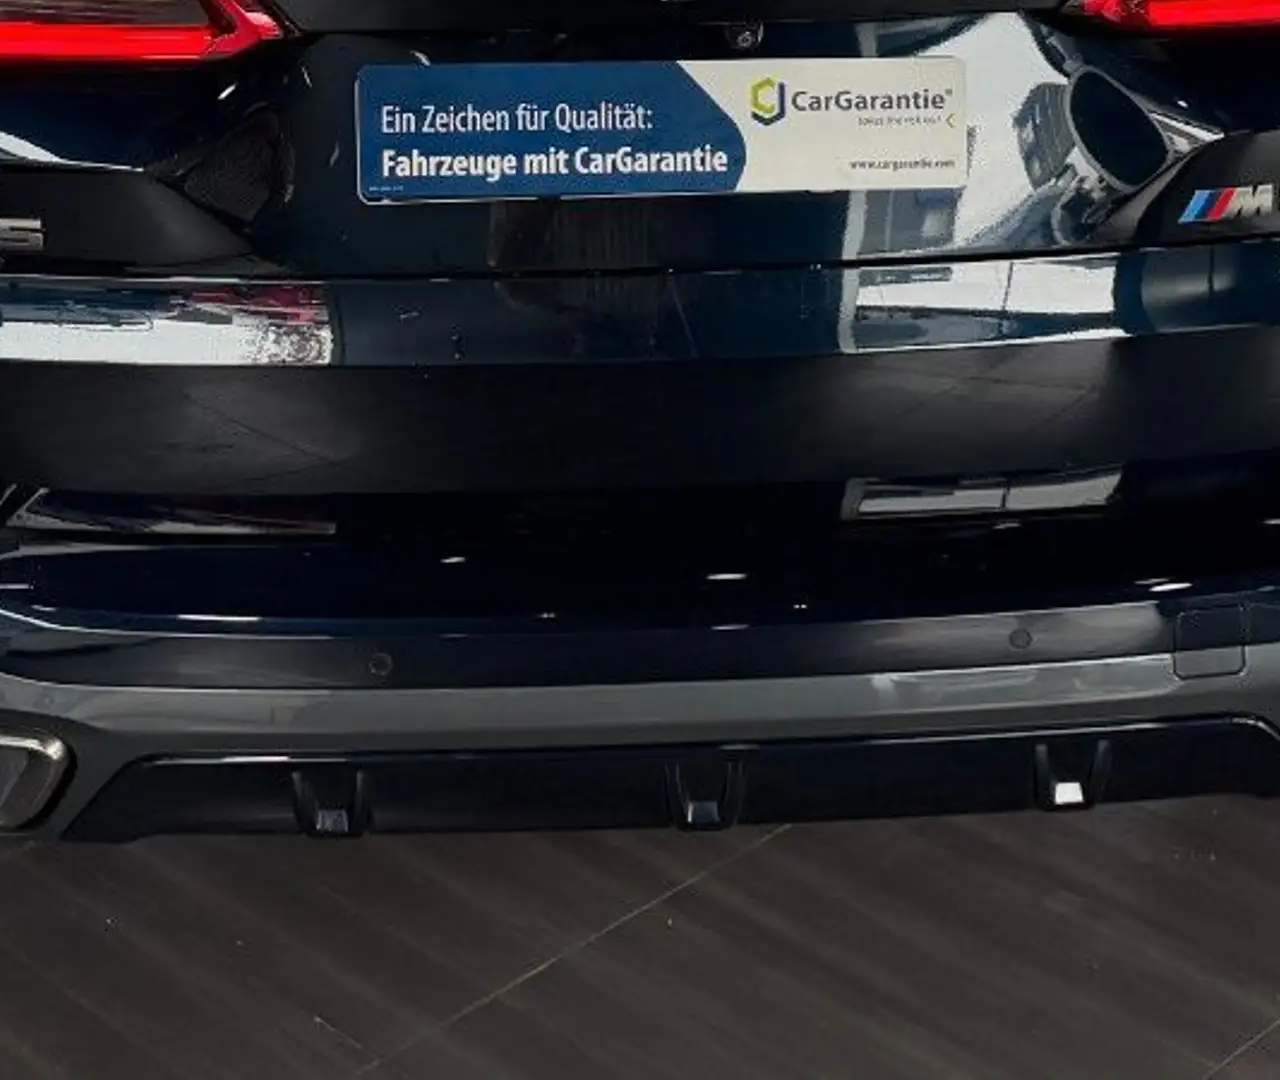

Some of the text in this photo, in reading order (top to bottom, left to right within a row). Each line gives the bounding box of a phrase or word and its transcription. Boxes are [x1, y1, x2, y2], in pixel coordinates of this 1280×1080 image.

[381, 100, 654, 135] Ein Zeichen für Qualität:
[381, 142, 730, 183] Fahrzeuge mit CarGarantie
